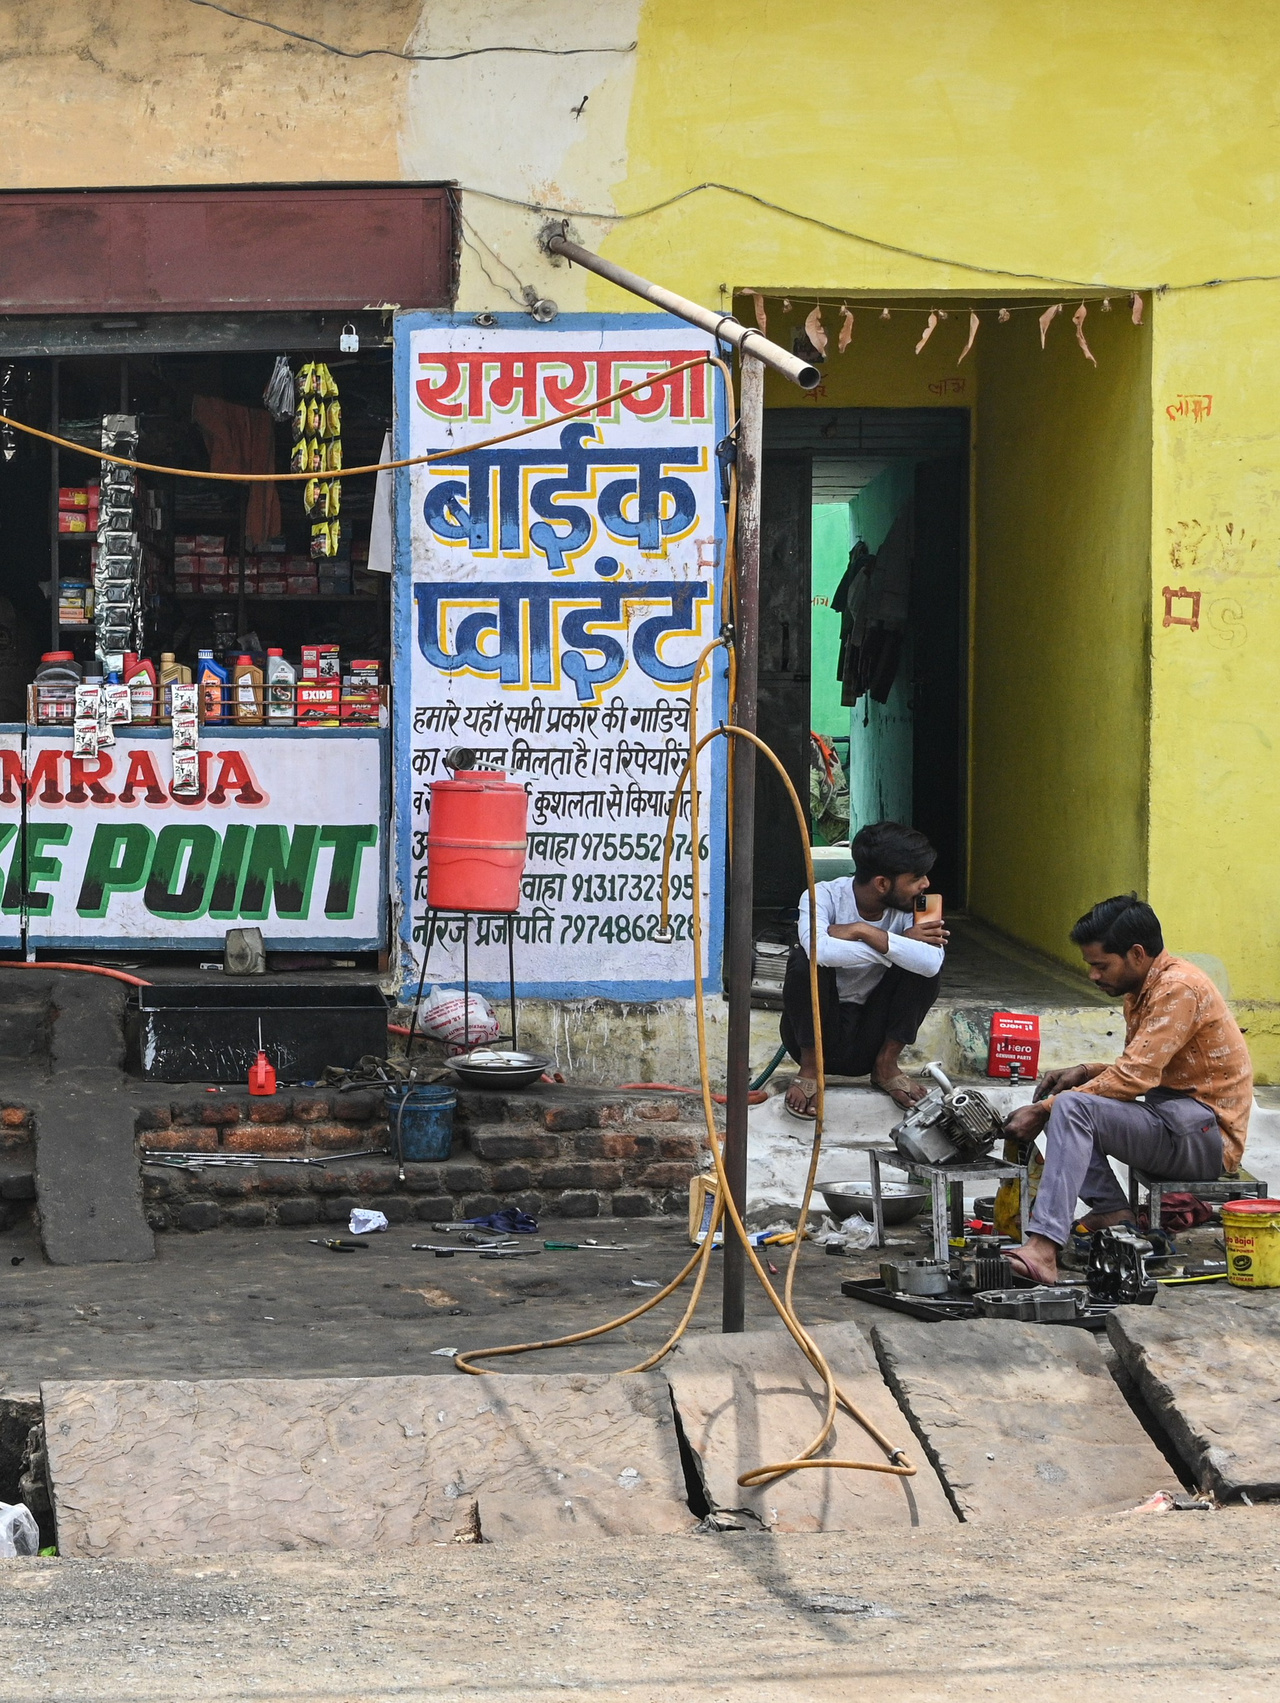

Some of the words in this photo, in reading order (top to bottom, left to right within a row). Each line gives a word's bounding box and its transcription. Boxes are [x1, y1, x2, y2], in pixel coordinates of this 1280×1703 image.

[416, 350, 711, 422] रामराजा
[424, 423, 702, 573] बाईक
[302, 690, 333, 700] EXIDE
[413, 700, 462, 737] हमारे
[505, 696, 546, 737] सभी
[545, 706, 600, 739] प्रकार
[601, 695, 629, 734] की
[411, 747, 441, 776] का
[509, 738, 574, 780] मिलता
[532, 791, 607, 826] कुशलता
[606, 784, 624, 823] से
[625, 782, 666, 818] किया
[76, 823, 379, 920] POINT
[412, 906, 474, 952] नीरज
[475, 906, 556, 947] प्रजापति
[1008, 1044, 1032, 1053] Hero
